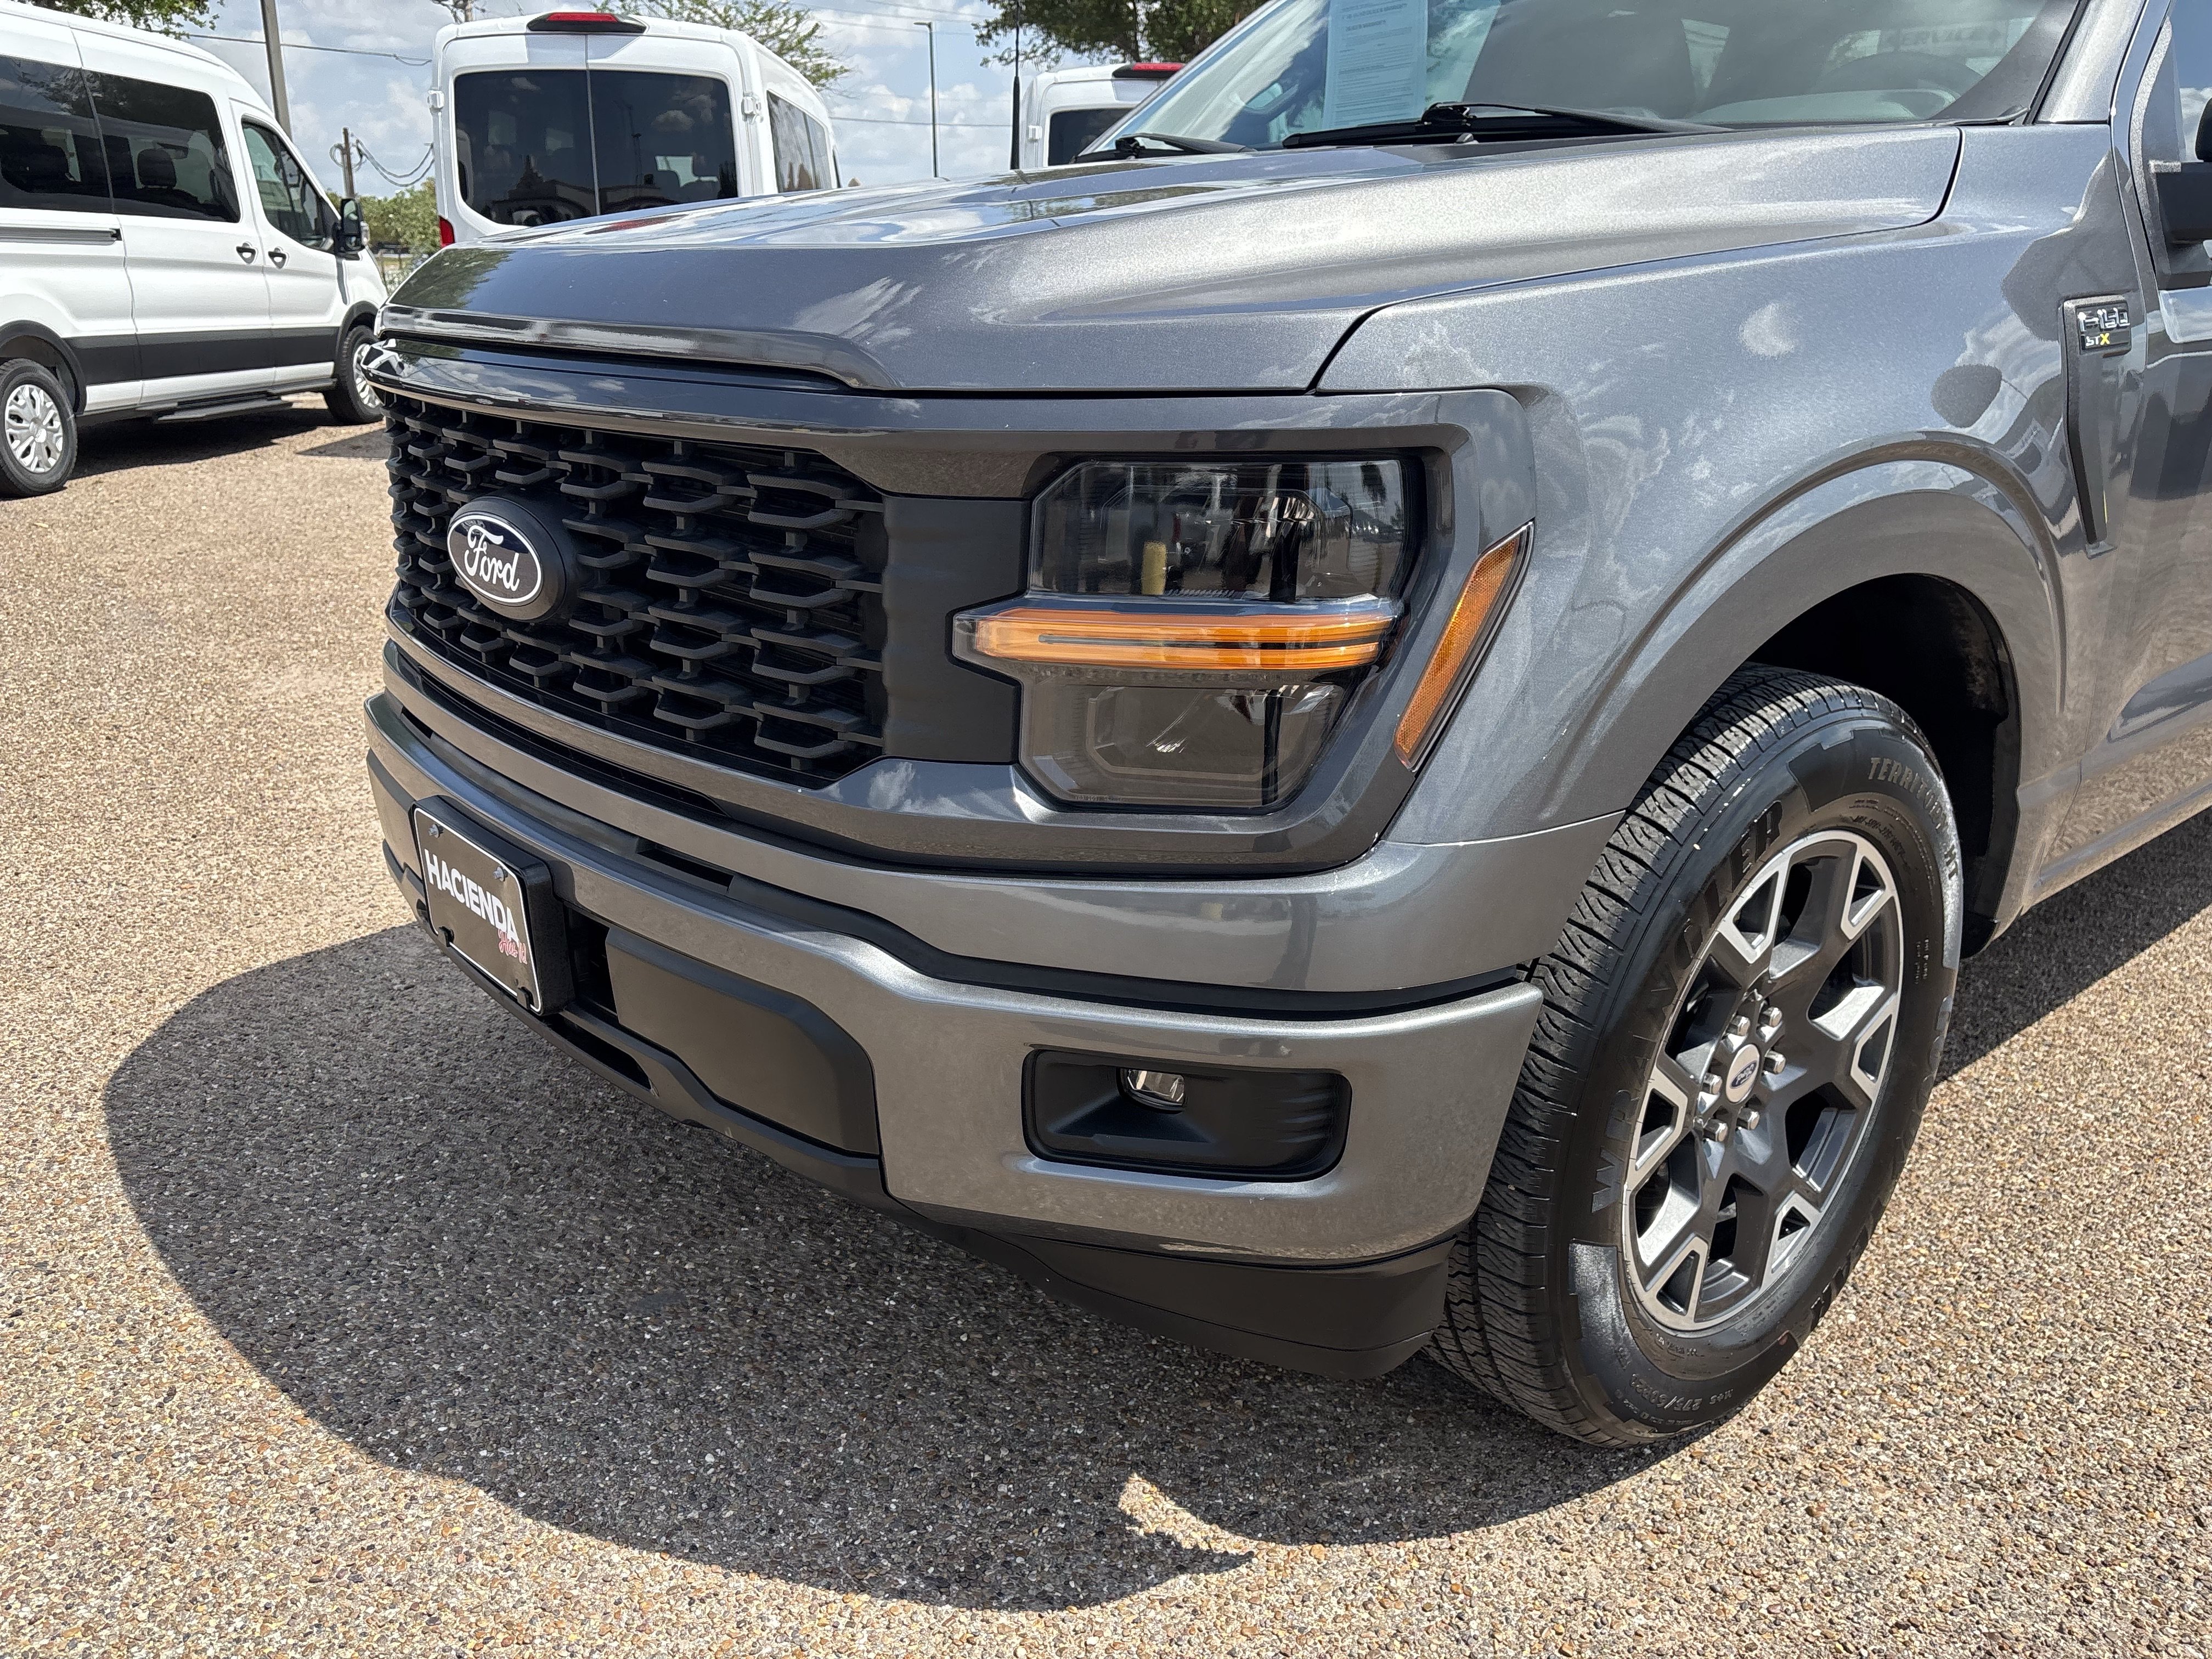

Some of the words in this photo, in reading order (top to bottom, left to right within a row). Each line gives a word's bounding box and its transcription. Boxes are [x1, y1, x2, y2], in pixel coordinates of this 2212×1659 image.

[2085, 332, 2111, 347] STX
[464, 524, 521, 592] Ford
[424, 849, 521, 947] HACIENDA
[1591, 800, 1784, 1215] WRANGLER
